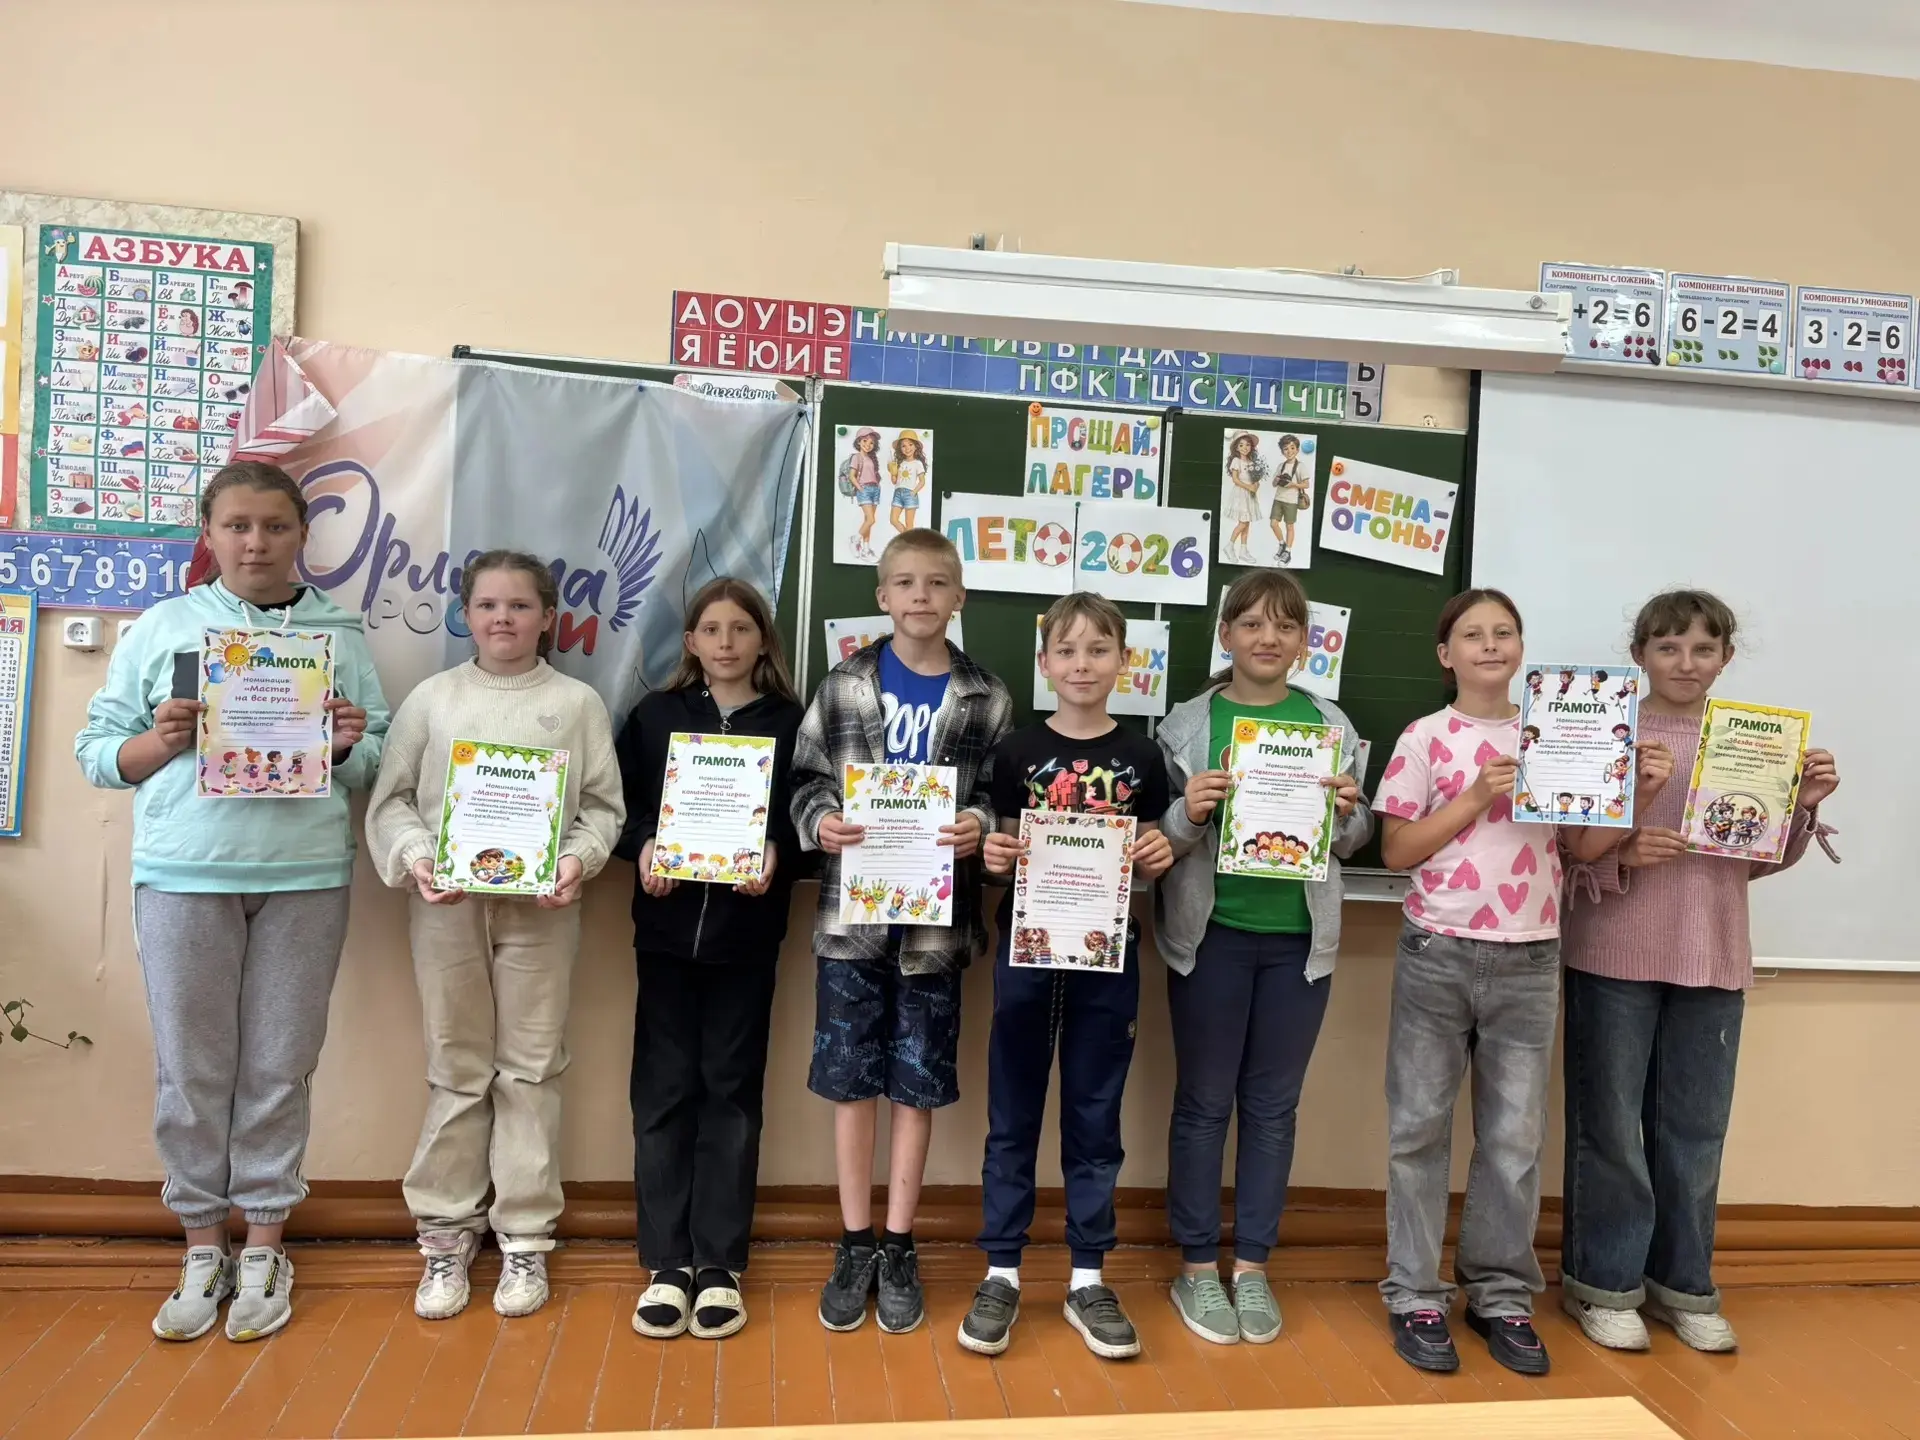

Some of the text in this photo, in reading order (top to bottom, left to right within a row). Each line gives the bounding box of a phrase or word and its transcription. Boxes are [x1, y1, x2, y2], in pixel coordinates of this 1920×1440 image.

[84, 235, 250, 272] АЗБУКА
[1551, 270, 1655, 286] КОМПОНЕНТЫ СЛОЖЕНИЯ
[1633, 288, 1652, 297] Сумма
[1678, 281, 1785, 297] КОМПОНЕНТЫ ВЫЧИТАНИЯ
[1804, 293, 1908, 309] КОМПОНЕНТЫ УМНОЖЕНИЯ
[1592, 300, 1651, 328] 2 6
[1682, 307, 1778, 338] 6 2 4
[1808, 319, 1901, 350] 3 2 6
[701, 382, 777, 400] Разговоры
[1027, 461, 1156, 500] ЛАГЕРЬ
[296, 458, 608, 614] Орла
[1331, 507, 1446, 553] ОГОНЬ!
[15, 536, 29, 544] +1
[51, 538, 64, 546] +1
[151, 543, 164, 551] +1
[946, 516, 1204, 579] ЛЕТО 2026
[0, 552, 18, 584] 5
[30, 553, 52, 586] 6
[61, 555, 83, 587] 7
[95, 556, 116, 589] 8
[127, 558, 148, 591] 9
[249, 656, 317, 669] ГРАМОТА
[244, 686, 291, 694] «Мастер
[251, 694, 267, 702] все
[1548, 701, 1607, 714] ГРАМОТА
[1728, 717, 1783, 734] ГРАМОТА
[1258, 744, 1313, 758] ГРАМОТА
[692, 755, 746, 767] ГРАМОТА
[476, 765, 536, 781] ГРАМОТА
[871, 799, 927, 810] ГРАМОТА
[1046, 835, 1105, 849] ГРАМОТА
